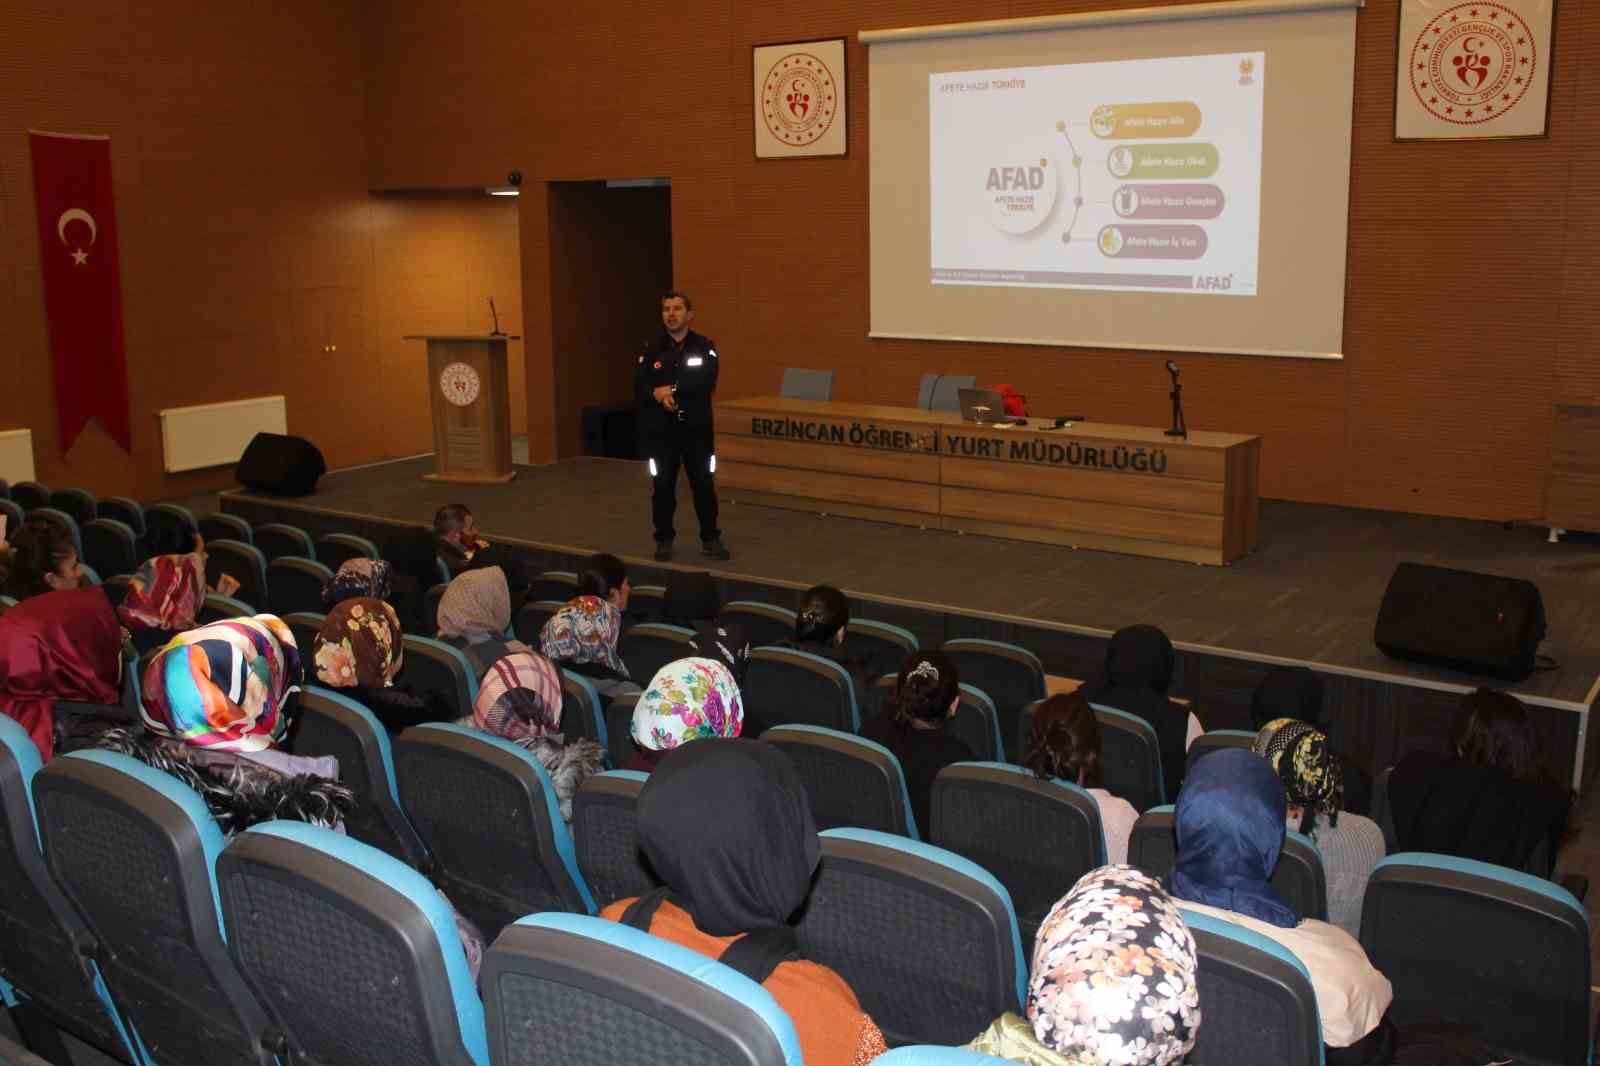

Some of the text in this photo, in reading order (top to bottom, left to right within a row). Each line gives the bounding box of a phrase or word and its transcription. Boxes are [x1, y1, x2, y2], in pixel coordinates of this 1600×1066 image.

[985, 166, 1044, 191] AFAD
[1196, 275, 1232, 290] AFAD
[752, 416, 1168, 474] ERZİNCAN ÖĞRENİ YURT MÜDÜRLÜĞÜ
